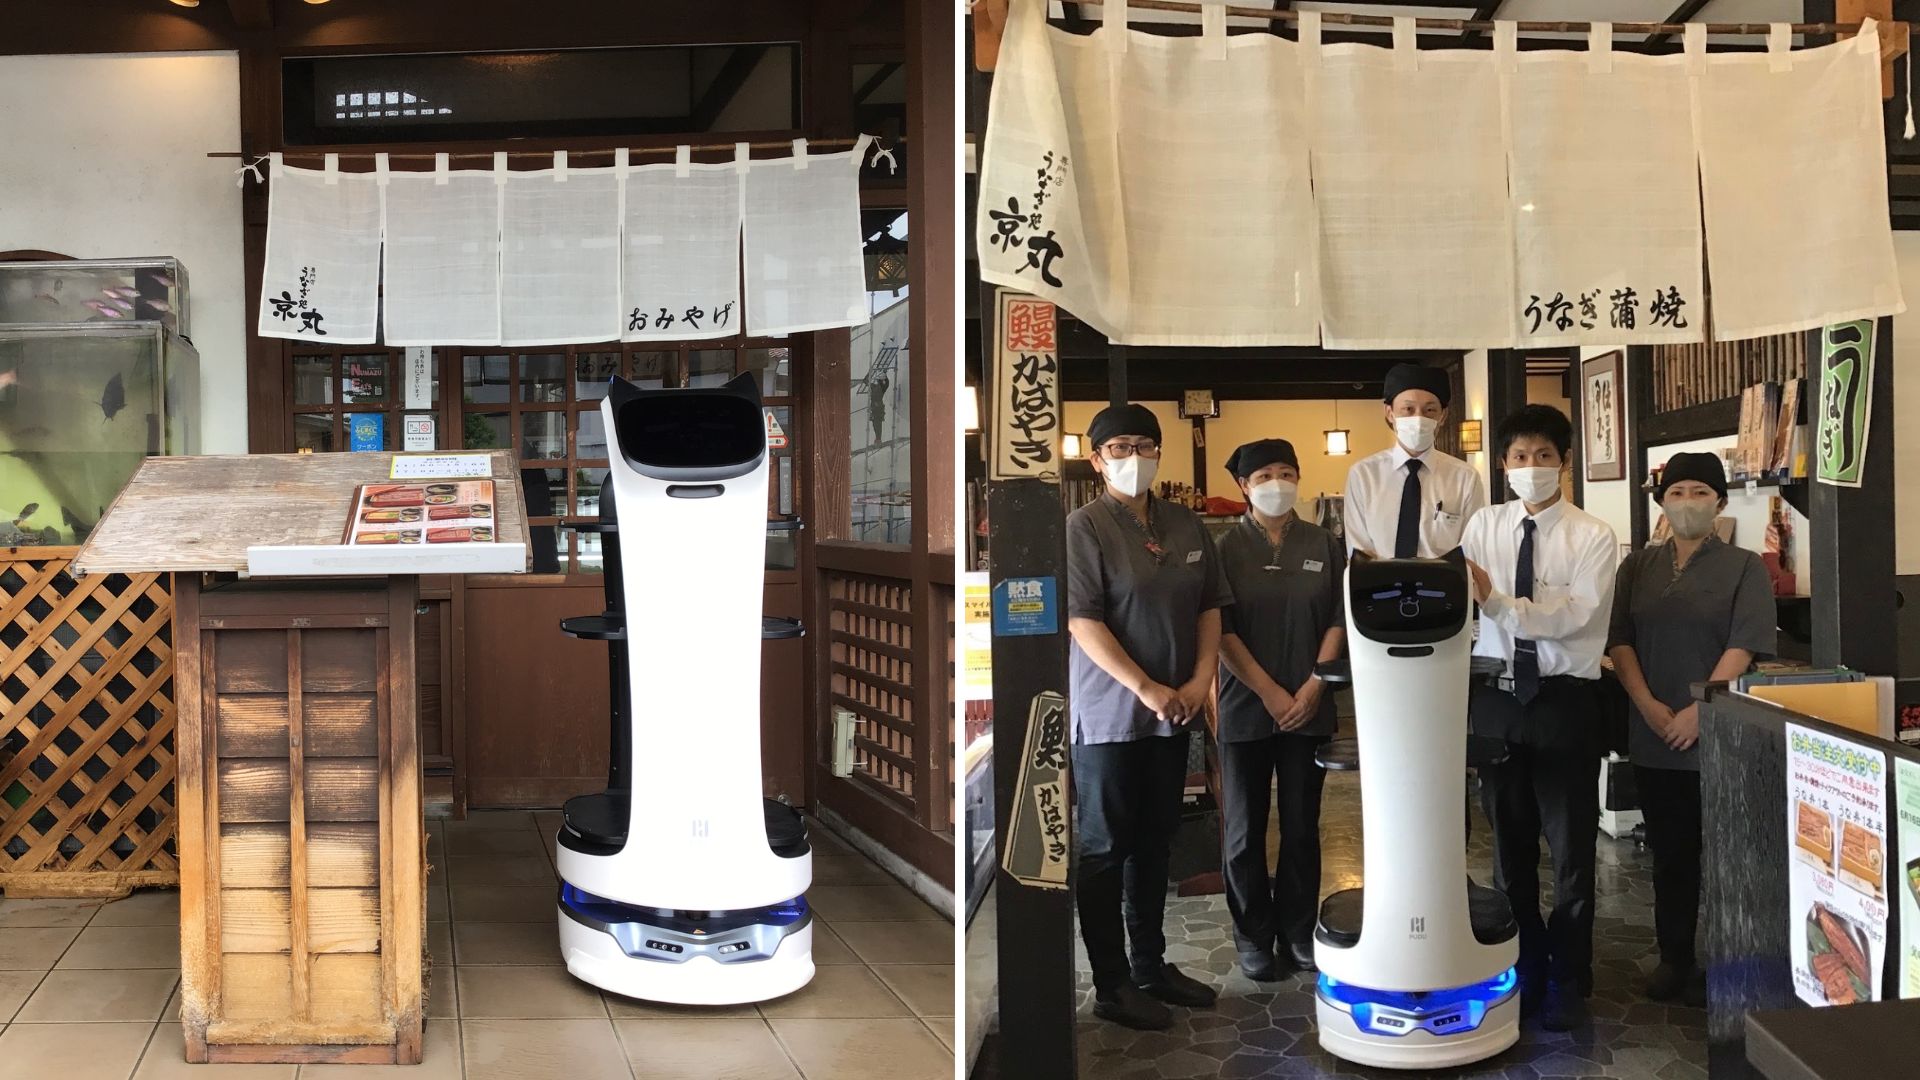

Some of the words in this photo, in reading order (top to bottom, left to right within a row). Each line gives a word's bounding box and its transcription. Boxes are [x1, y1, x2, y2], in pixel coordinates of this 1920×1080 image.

[1028, 150, 1053, 230] うなぎ処
[1052, 156, 1068, 187] 専門店
[989, 196, 1064, 288] 京丸
[268, 291, 328, 336] 京丸
[628, 300, 736, 332] おみやげ
[1524, 285, 1688, 334] うなぎ蒲焼
[1009, 352, 1058, 470] かばやき
